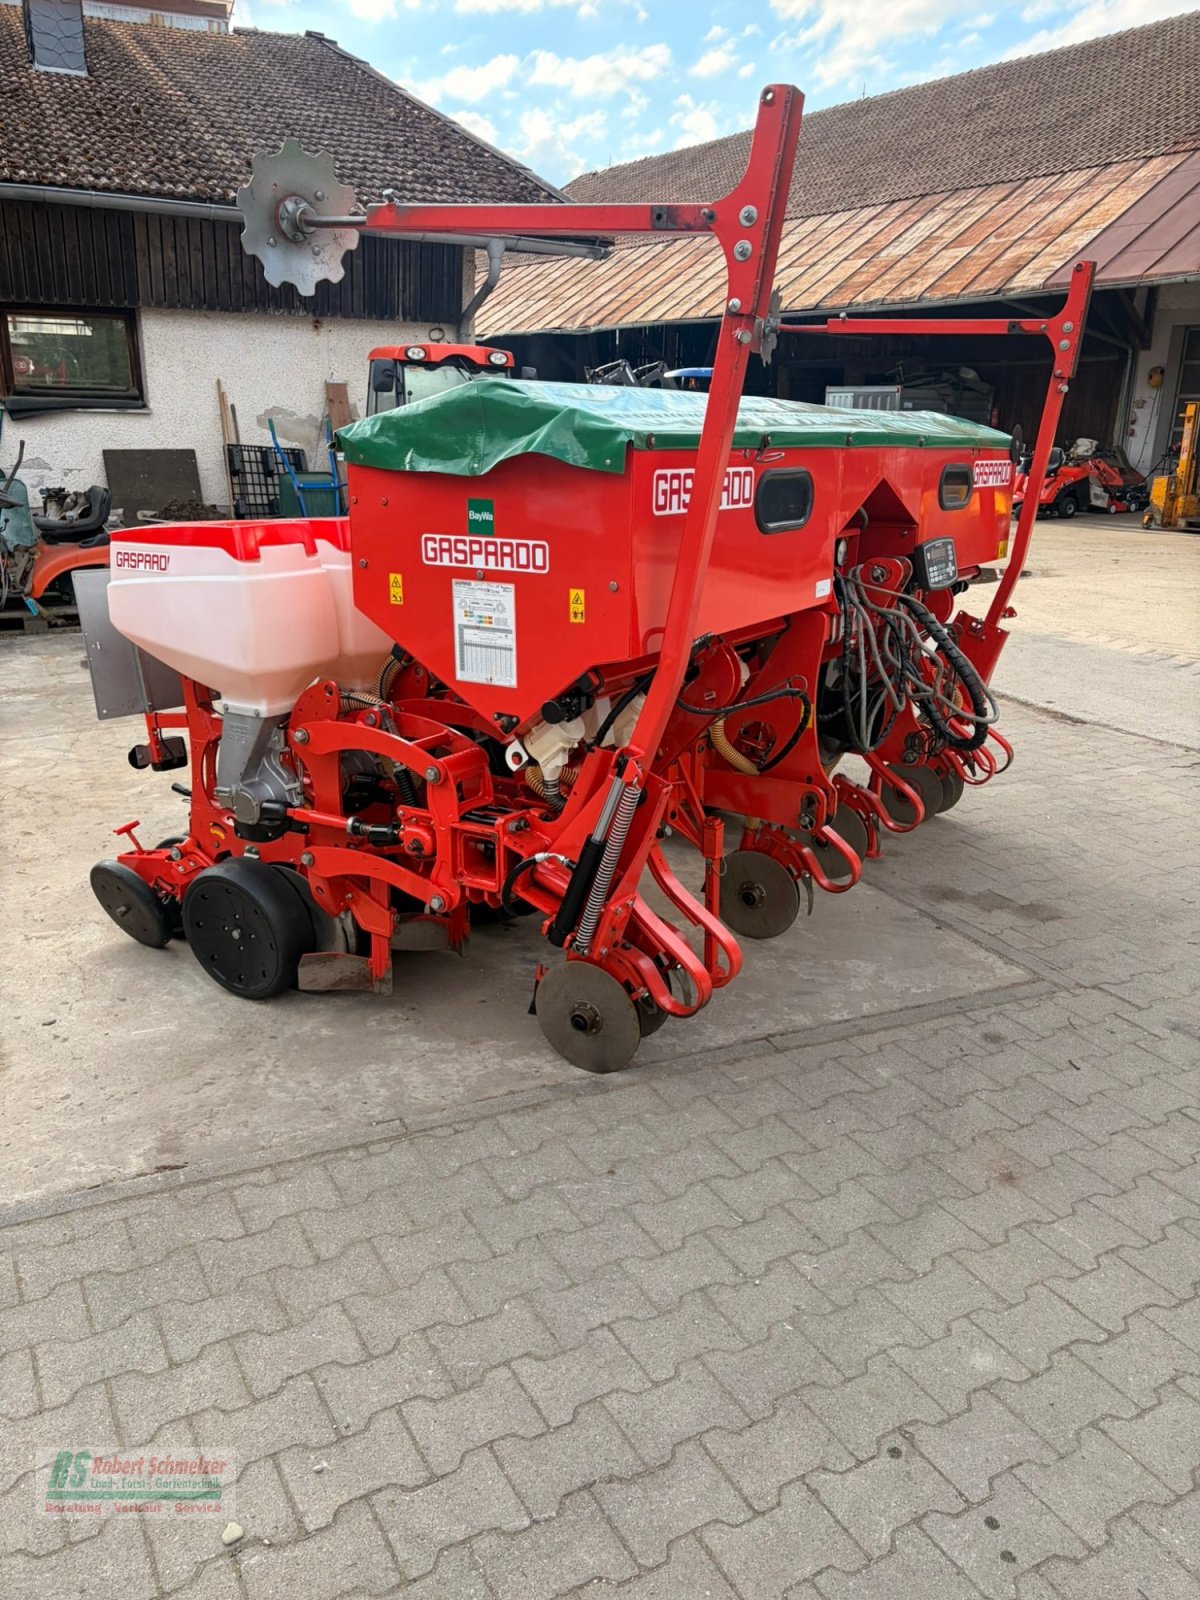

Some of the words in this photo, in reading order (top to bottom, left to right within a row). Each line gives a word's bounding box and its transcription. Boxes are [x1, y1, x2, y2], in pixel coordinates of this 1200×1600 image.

[974, 462, 1011, 485] GASPARDO
[655, 470, 753, 513] GASRDO
[468, 510, 494, 522] BayWa
[116, 551, 170, 572] GASPARD
[423, 536, 547, 571] GASPARDO
